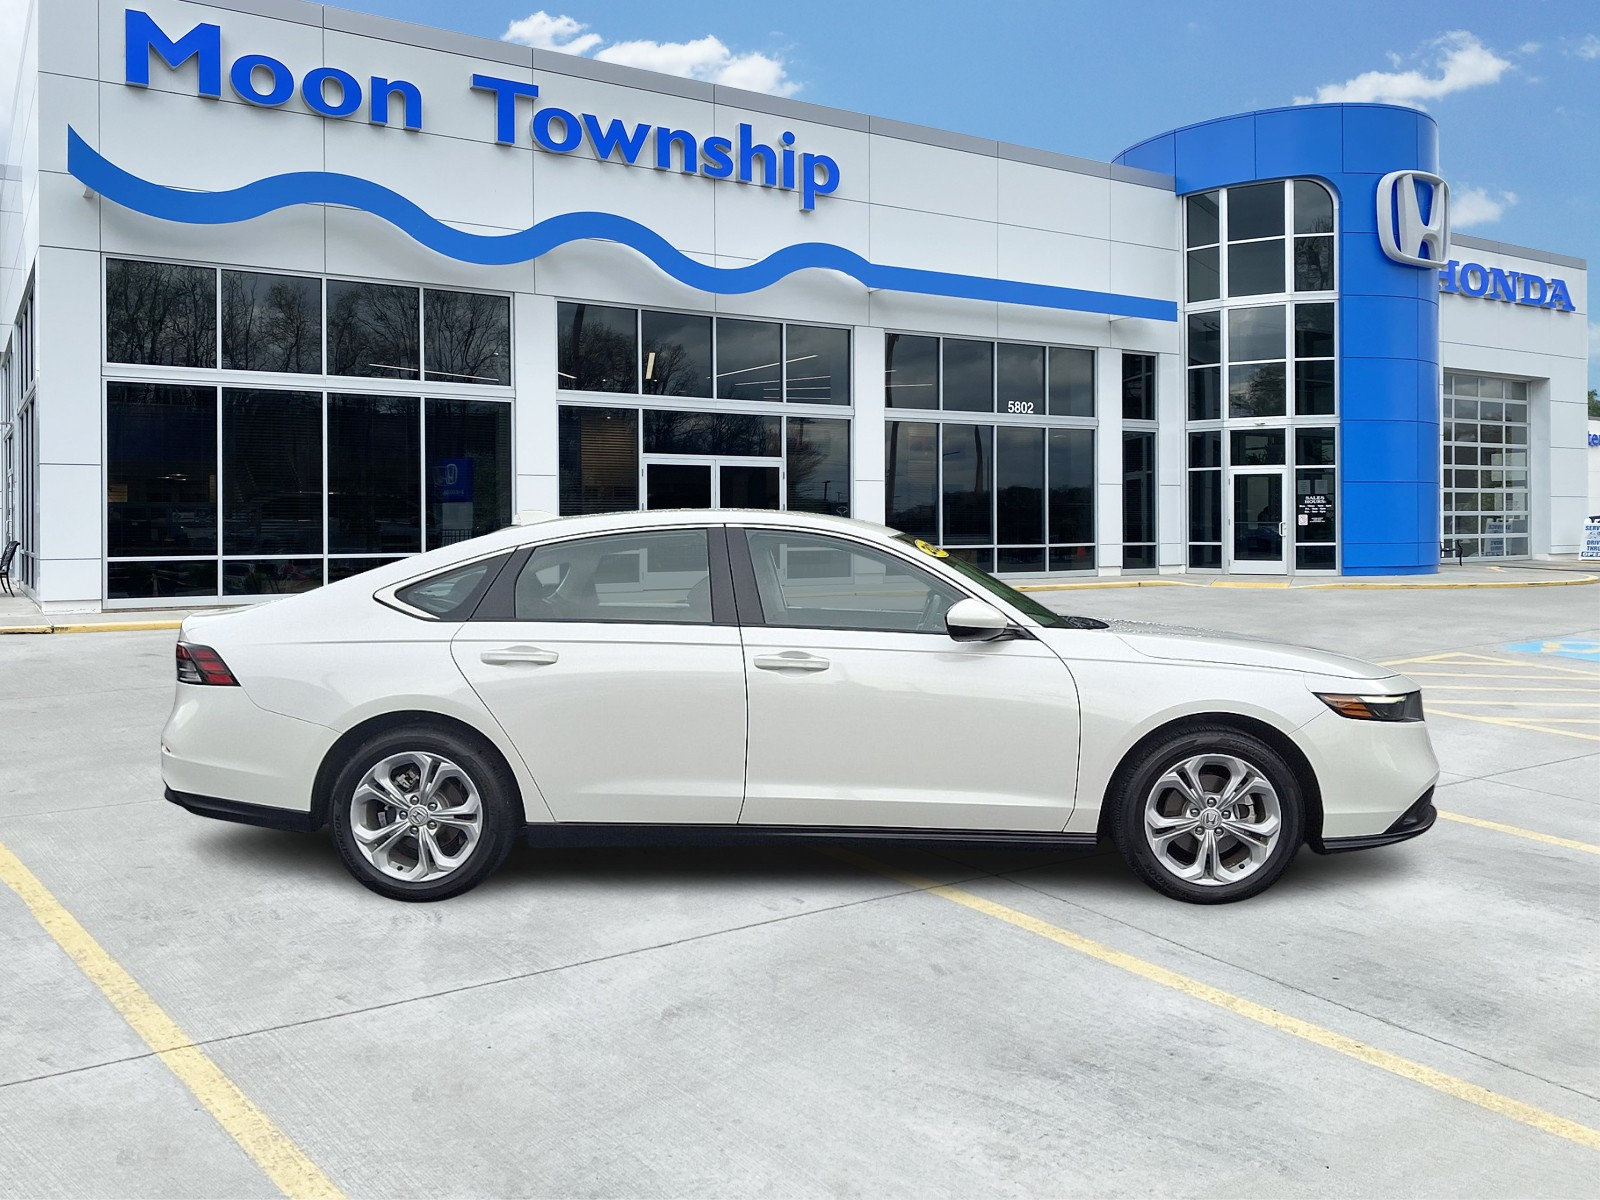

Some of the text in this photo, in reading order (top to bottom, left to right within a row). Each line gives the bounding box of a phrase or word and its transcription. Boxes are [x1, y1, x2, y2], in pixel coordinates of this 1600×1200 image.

[125, 9, 841, 212] Moon Township
[1438, 260, 1576, 311] HONDA
[1007, 400, 1034, 414] 5802
